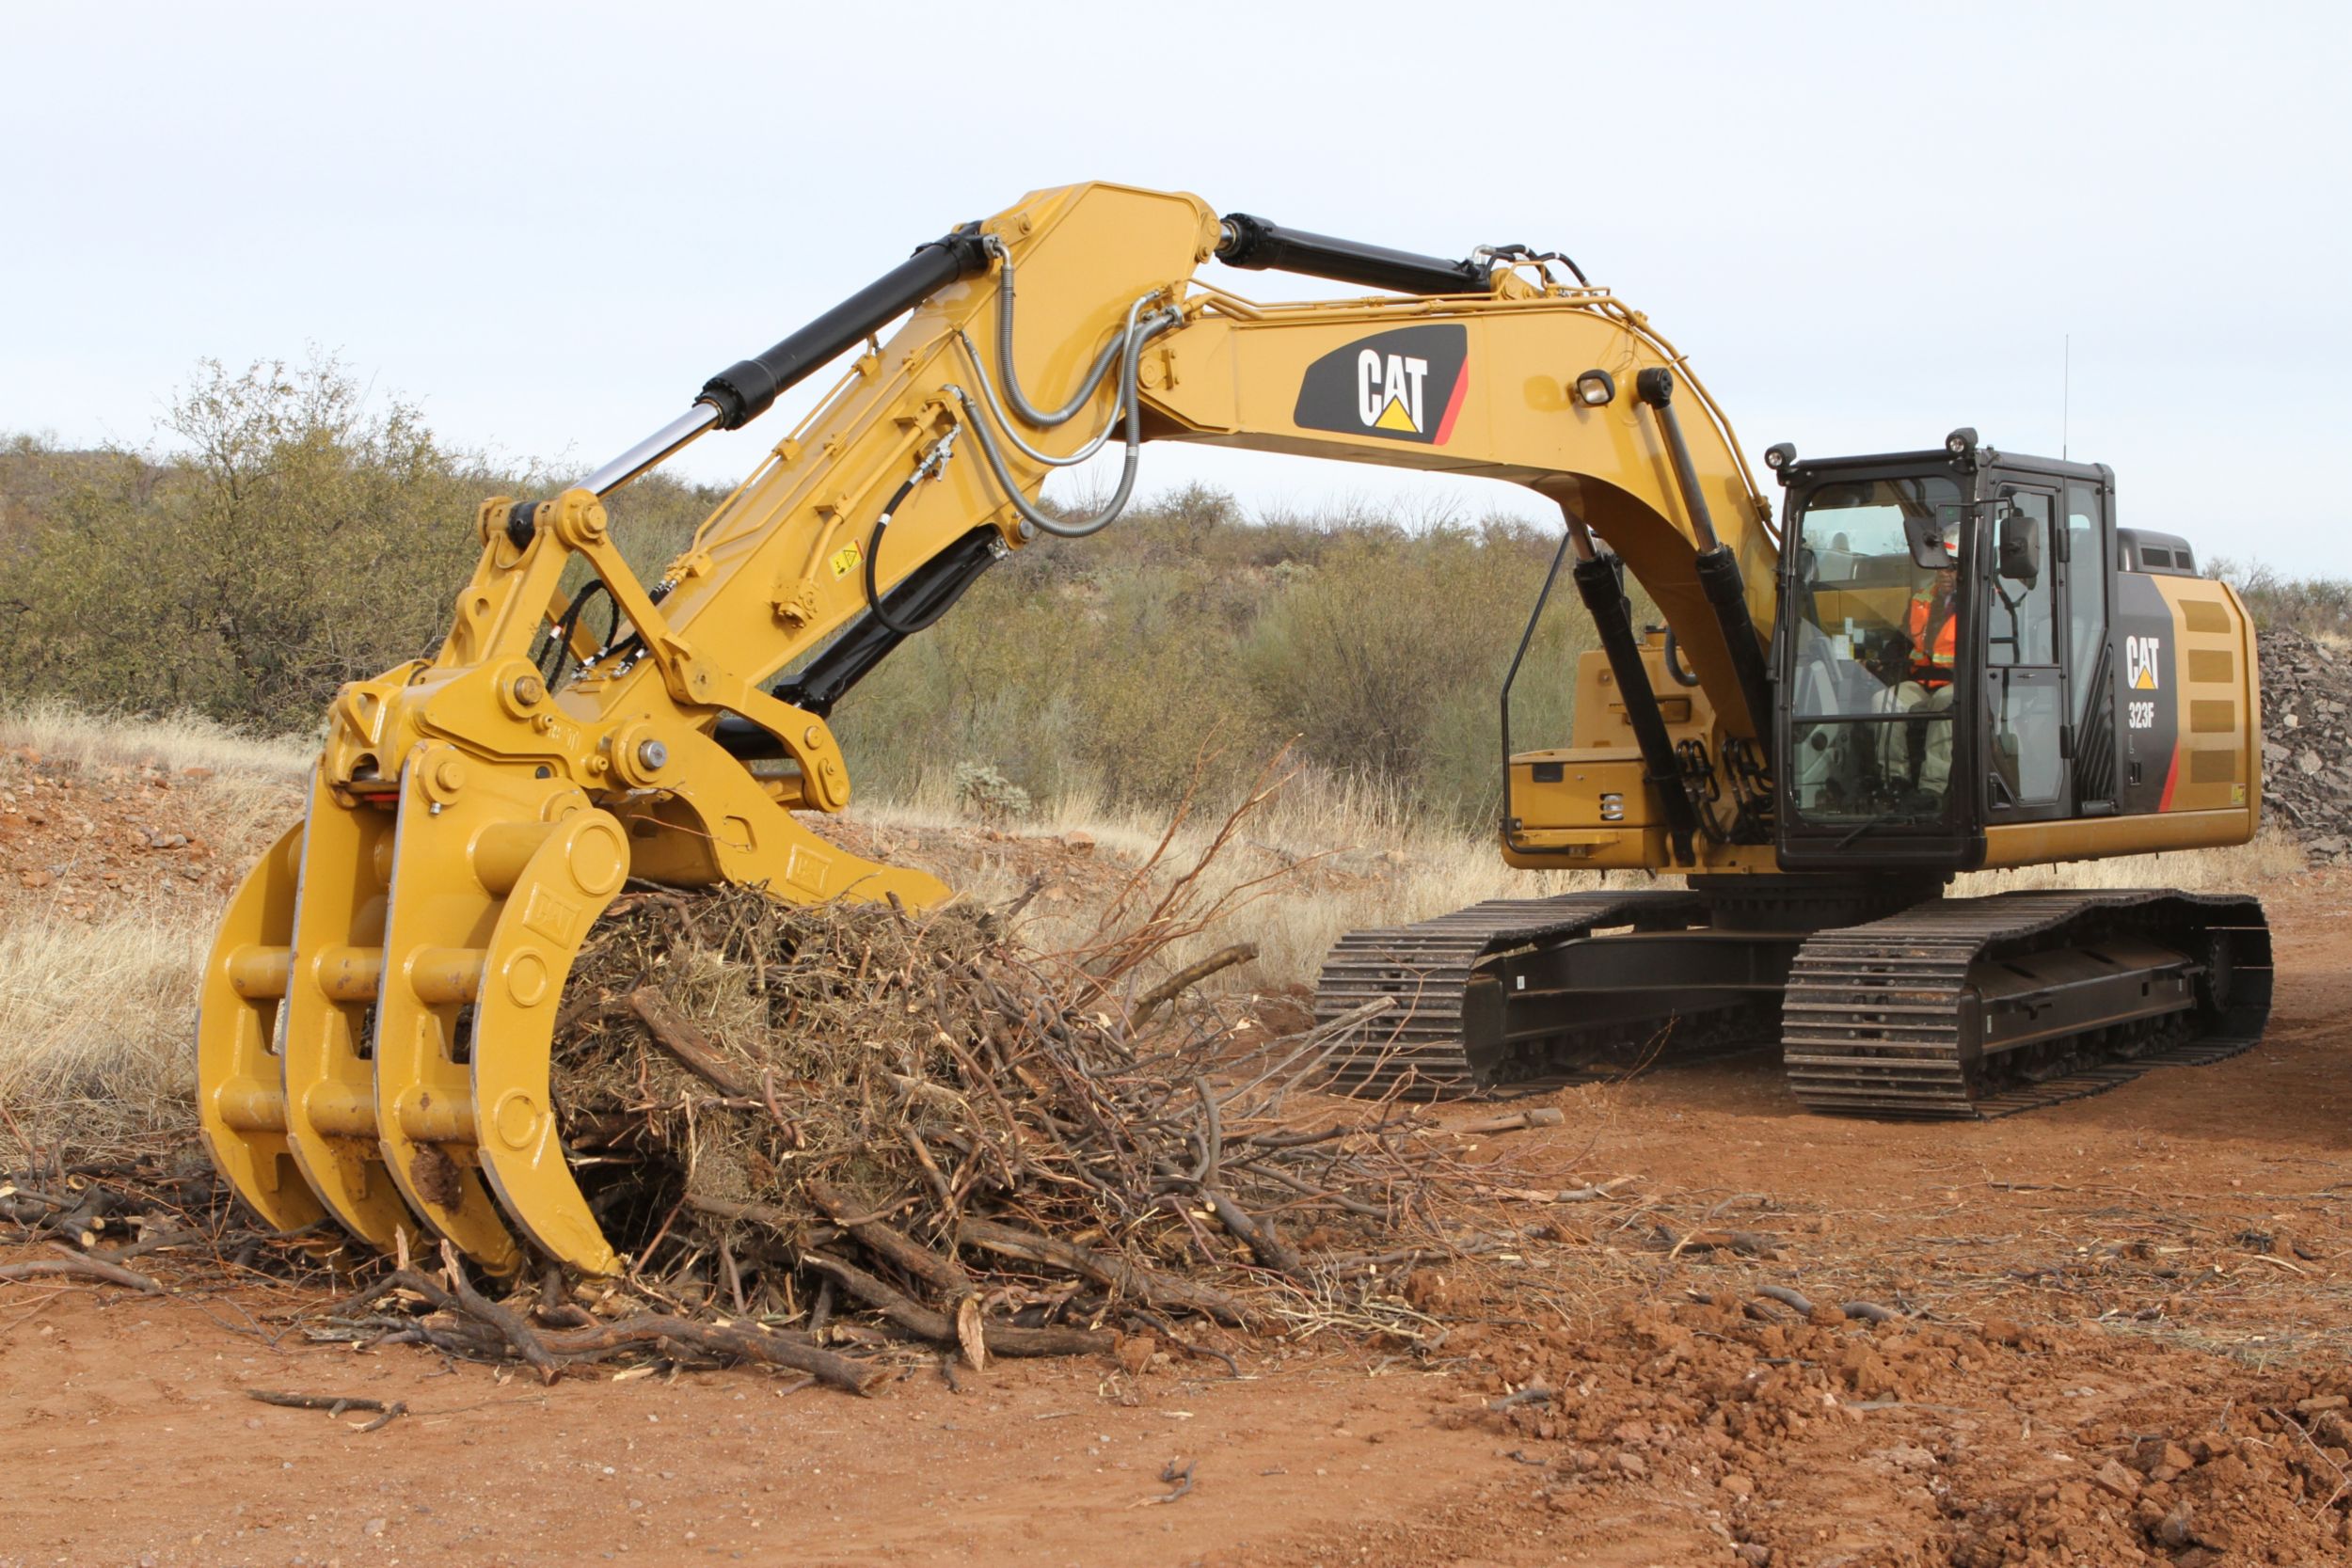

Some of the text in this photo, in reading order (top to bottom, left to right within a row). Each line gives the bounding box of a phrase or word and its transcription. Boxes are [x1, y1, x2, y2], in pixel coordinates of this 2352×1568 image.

[1358, 349, 1428, 433] CAT
[2126, 636, 2159, 689] CAT
[2128, 702, 2154, 729] 323F
[533, 893, 578, 942] CAT
